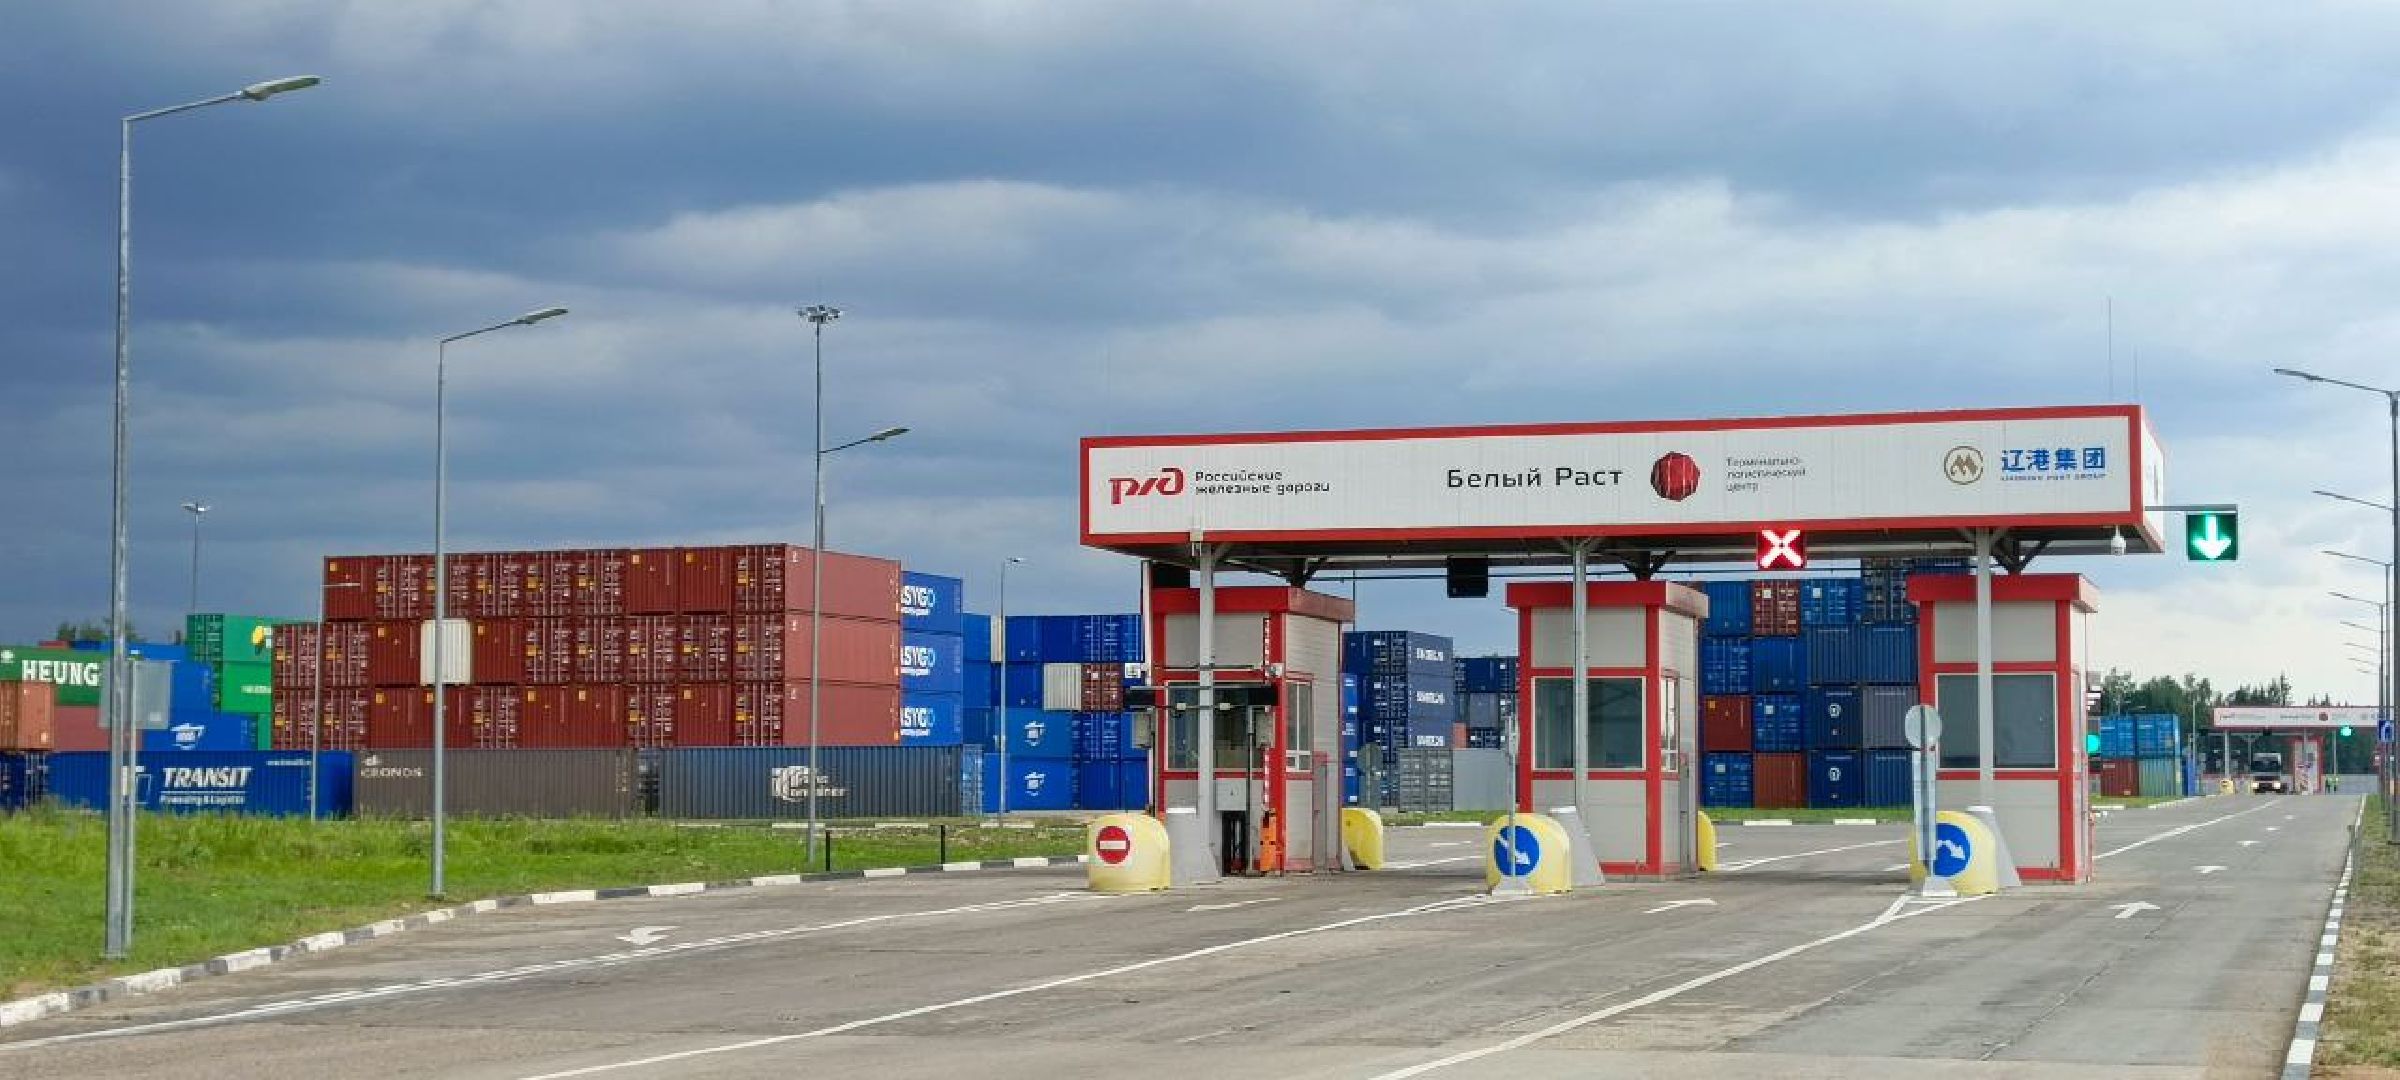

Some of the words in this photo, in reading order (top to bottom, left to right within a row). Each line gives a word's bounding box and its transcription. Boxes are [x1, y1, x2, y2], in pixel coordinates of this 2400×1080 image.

[2001, 448, 2105, 471] 辽港集团
[1195, 470, 1283, 482] Российские
[1447, 467, 1541, 488] Белый
[1555, 467, 1624, 486] Раст
[1195, 484, 1272, 495] железные
[1276, 482, 1330, 495] дороги
[22, 660, 100, 687] HEUNG
[162, 767, 251, 787] TRANSIT
